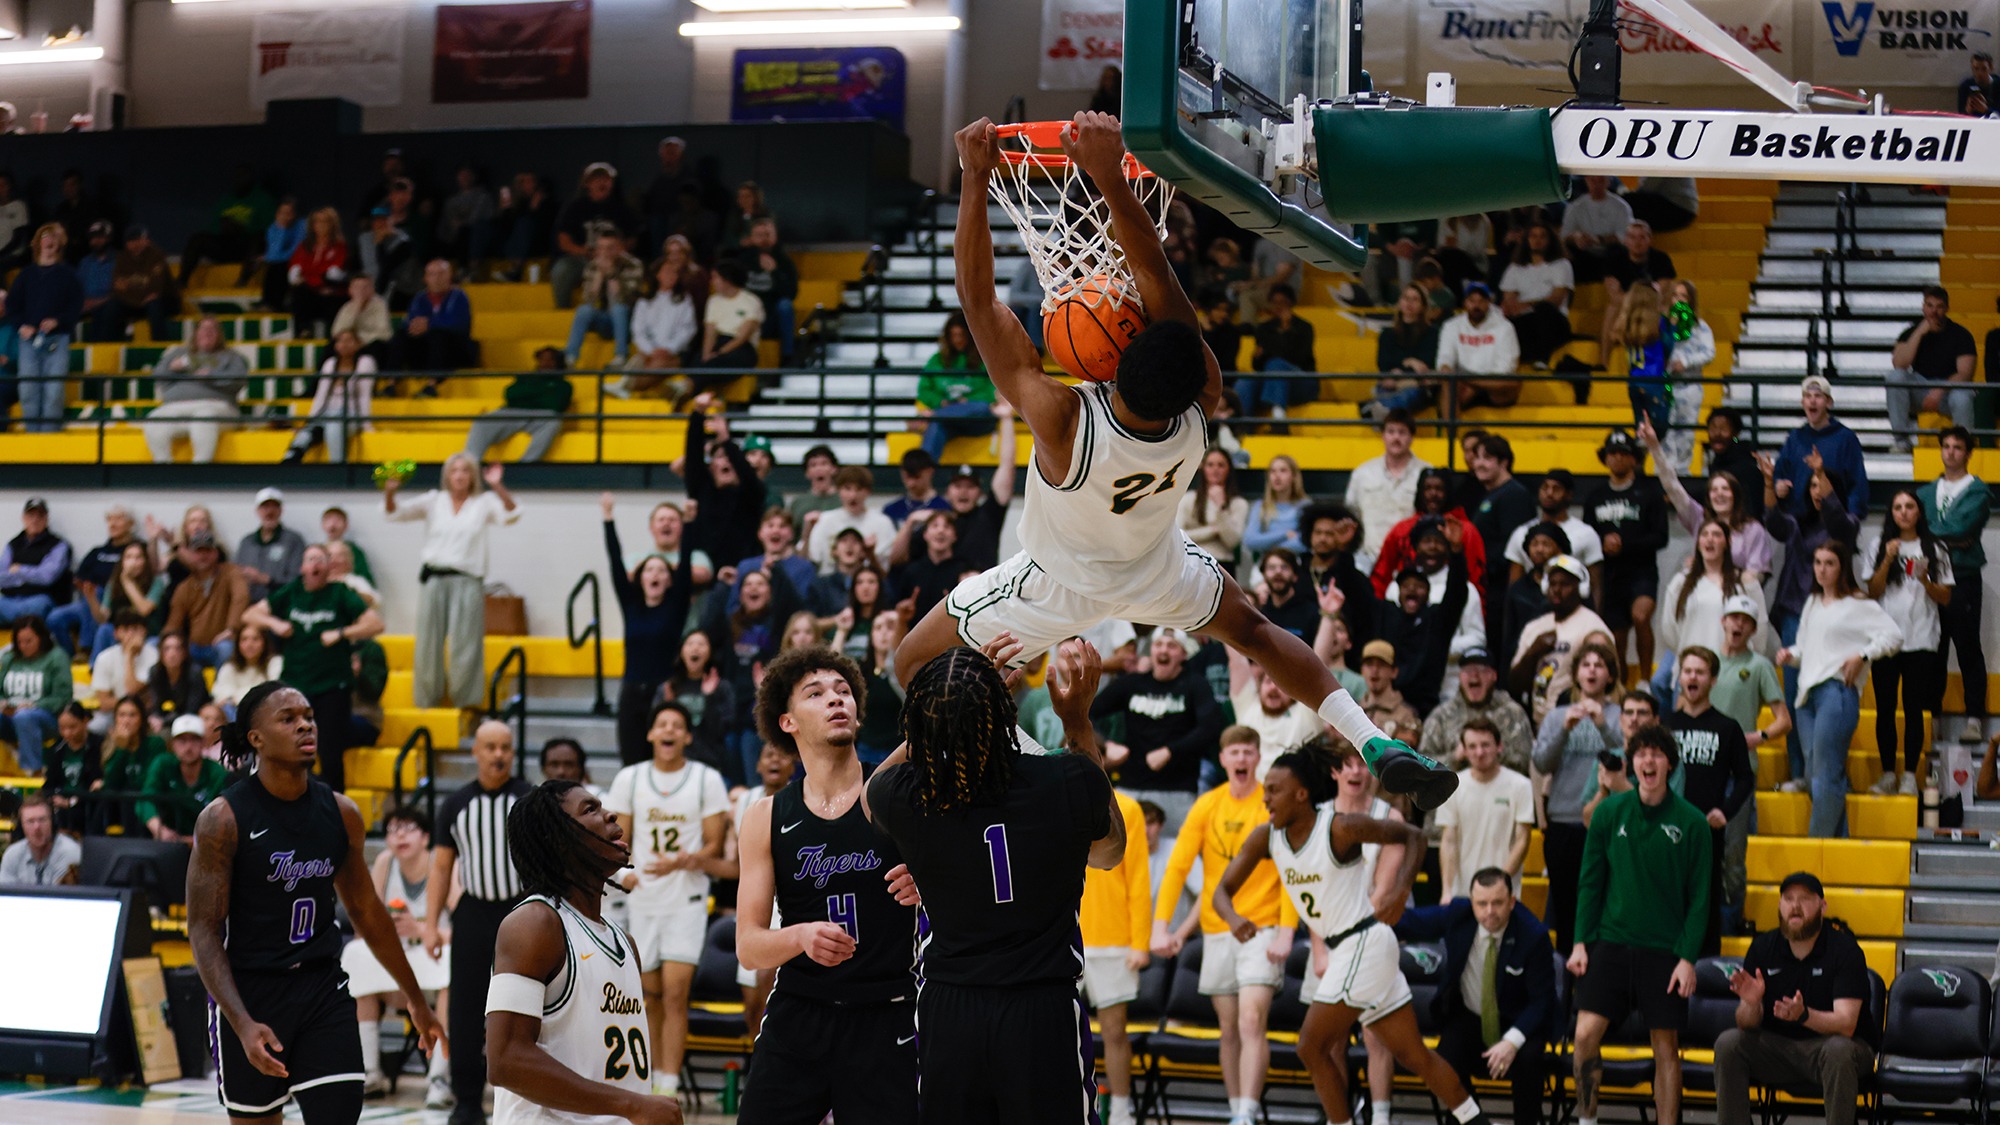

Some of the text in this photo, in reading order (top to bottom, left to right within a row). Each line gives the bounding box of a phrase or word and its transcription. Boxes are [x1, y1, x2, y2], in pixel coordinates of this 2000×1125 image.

[1877, 10, 1968, 29] VISION
[1083, 36, 1123, 60] Sta
[1880, 31, 1968, 50] BANK
[1578, 117, 1971, 163] OBU Basketball
[1117, 318, 1139, 340] EV
[1109, 457, 1186, 515] 21
[650, 827, 682, 853] 12
[266, 849, 335, 892] Tigers
[793, 843, 882, 889] Tigers
[983, 823, 1014, 904] 1
[1284, 868, 1323, 885] Bison
[289, 897, 316, 944] 0
[826, 893, 860, 944] 4
[1300, 892, 1322, 919] 2
[600, 981, 643, 1015] Bison
[604, 1025, 649, 1081] 20
